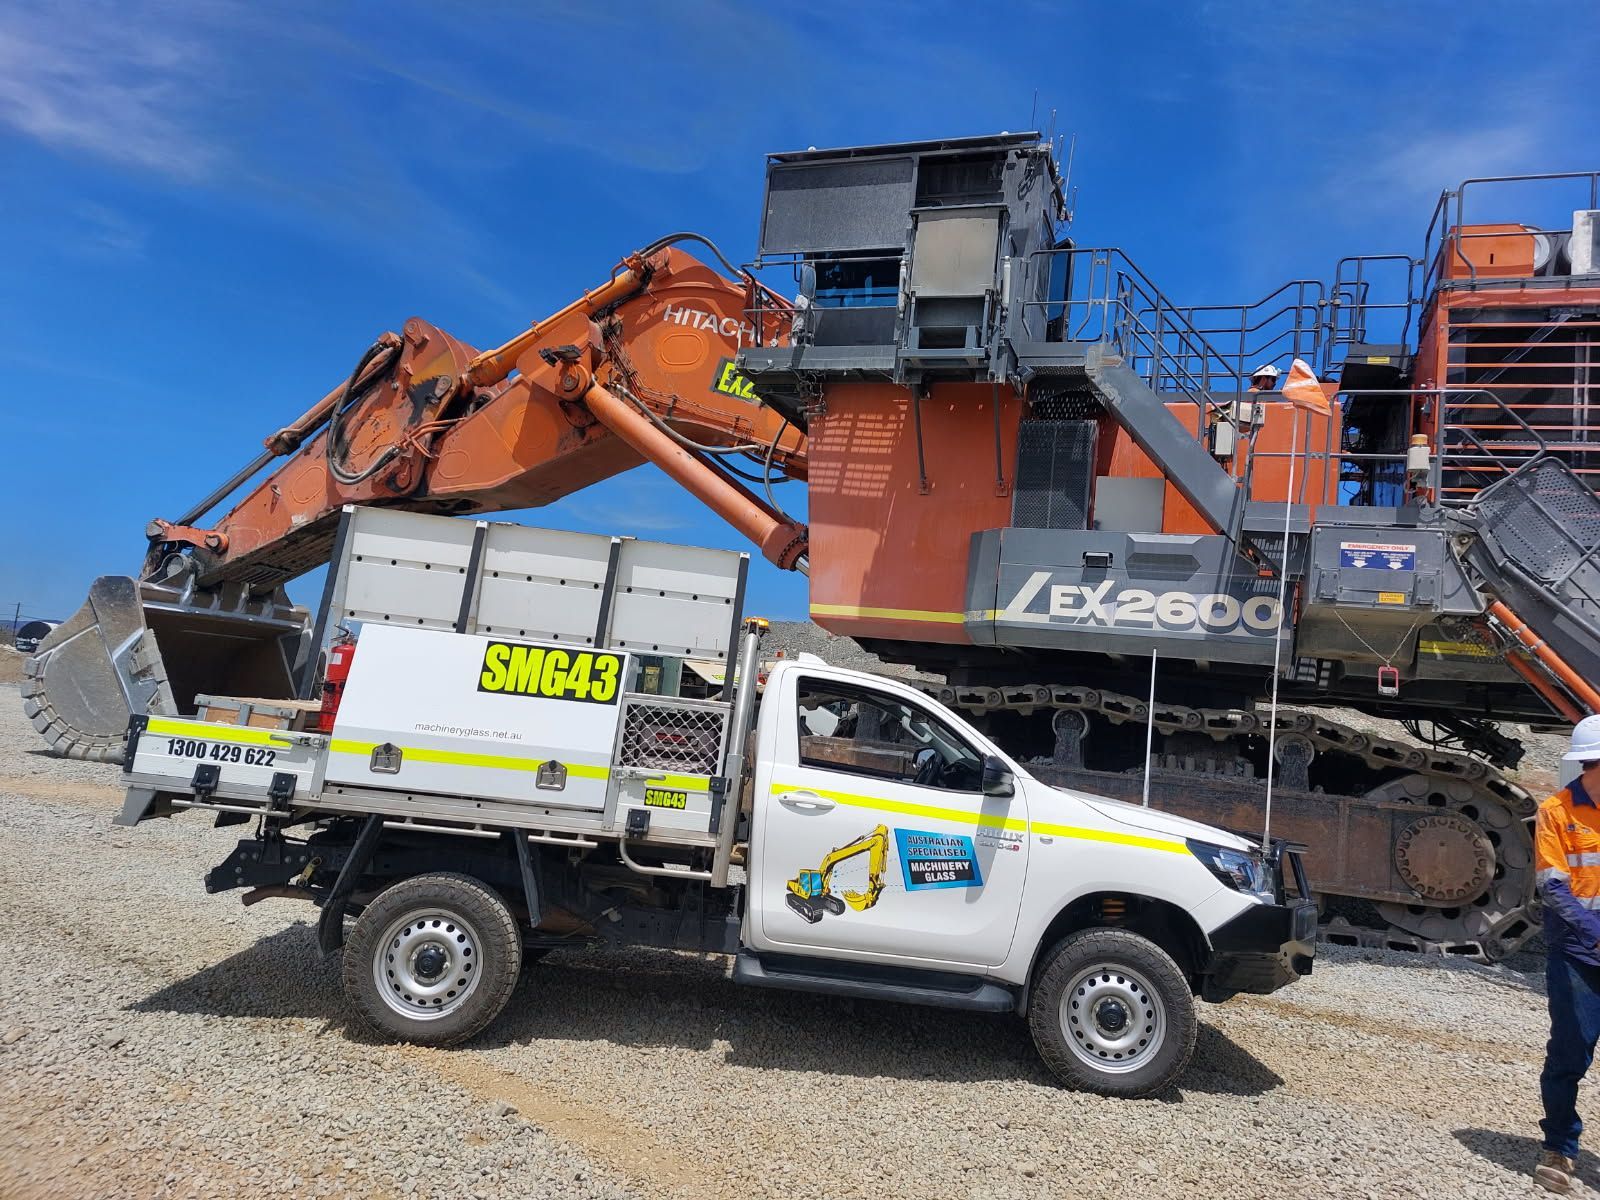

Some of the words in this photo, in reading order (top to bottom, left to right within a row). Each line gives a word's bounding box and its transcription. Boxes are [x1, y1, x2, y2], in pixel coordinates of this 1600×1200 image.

[663, 304, 766, 343] HITACH
[1347, 543, 1390, 551] EMERGENCY
[481, 644, 620, 701] SMG43
[414, 722, 523, 740] machineryglass.net.au
[167, 738, 206, 760] 1300
[209, 745, 241, 763] 429
[244, 748, 276, 767] 622
[645, 789, 686, 809] SMG43
[907, 835, 964, 847] AUSTRALIAN
[908, 847, 967, 857] SPECIALISED
[910, 861, 970, 872] MACHINERY
[925, 871, 956, 882] GLASS
